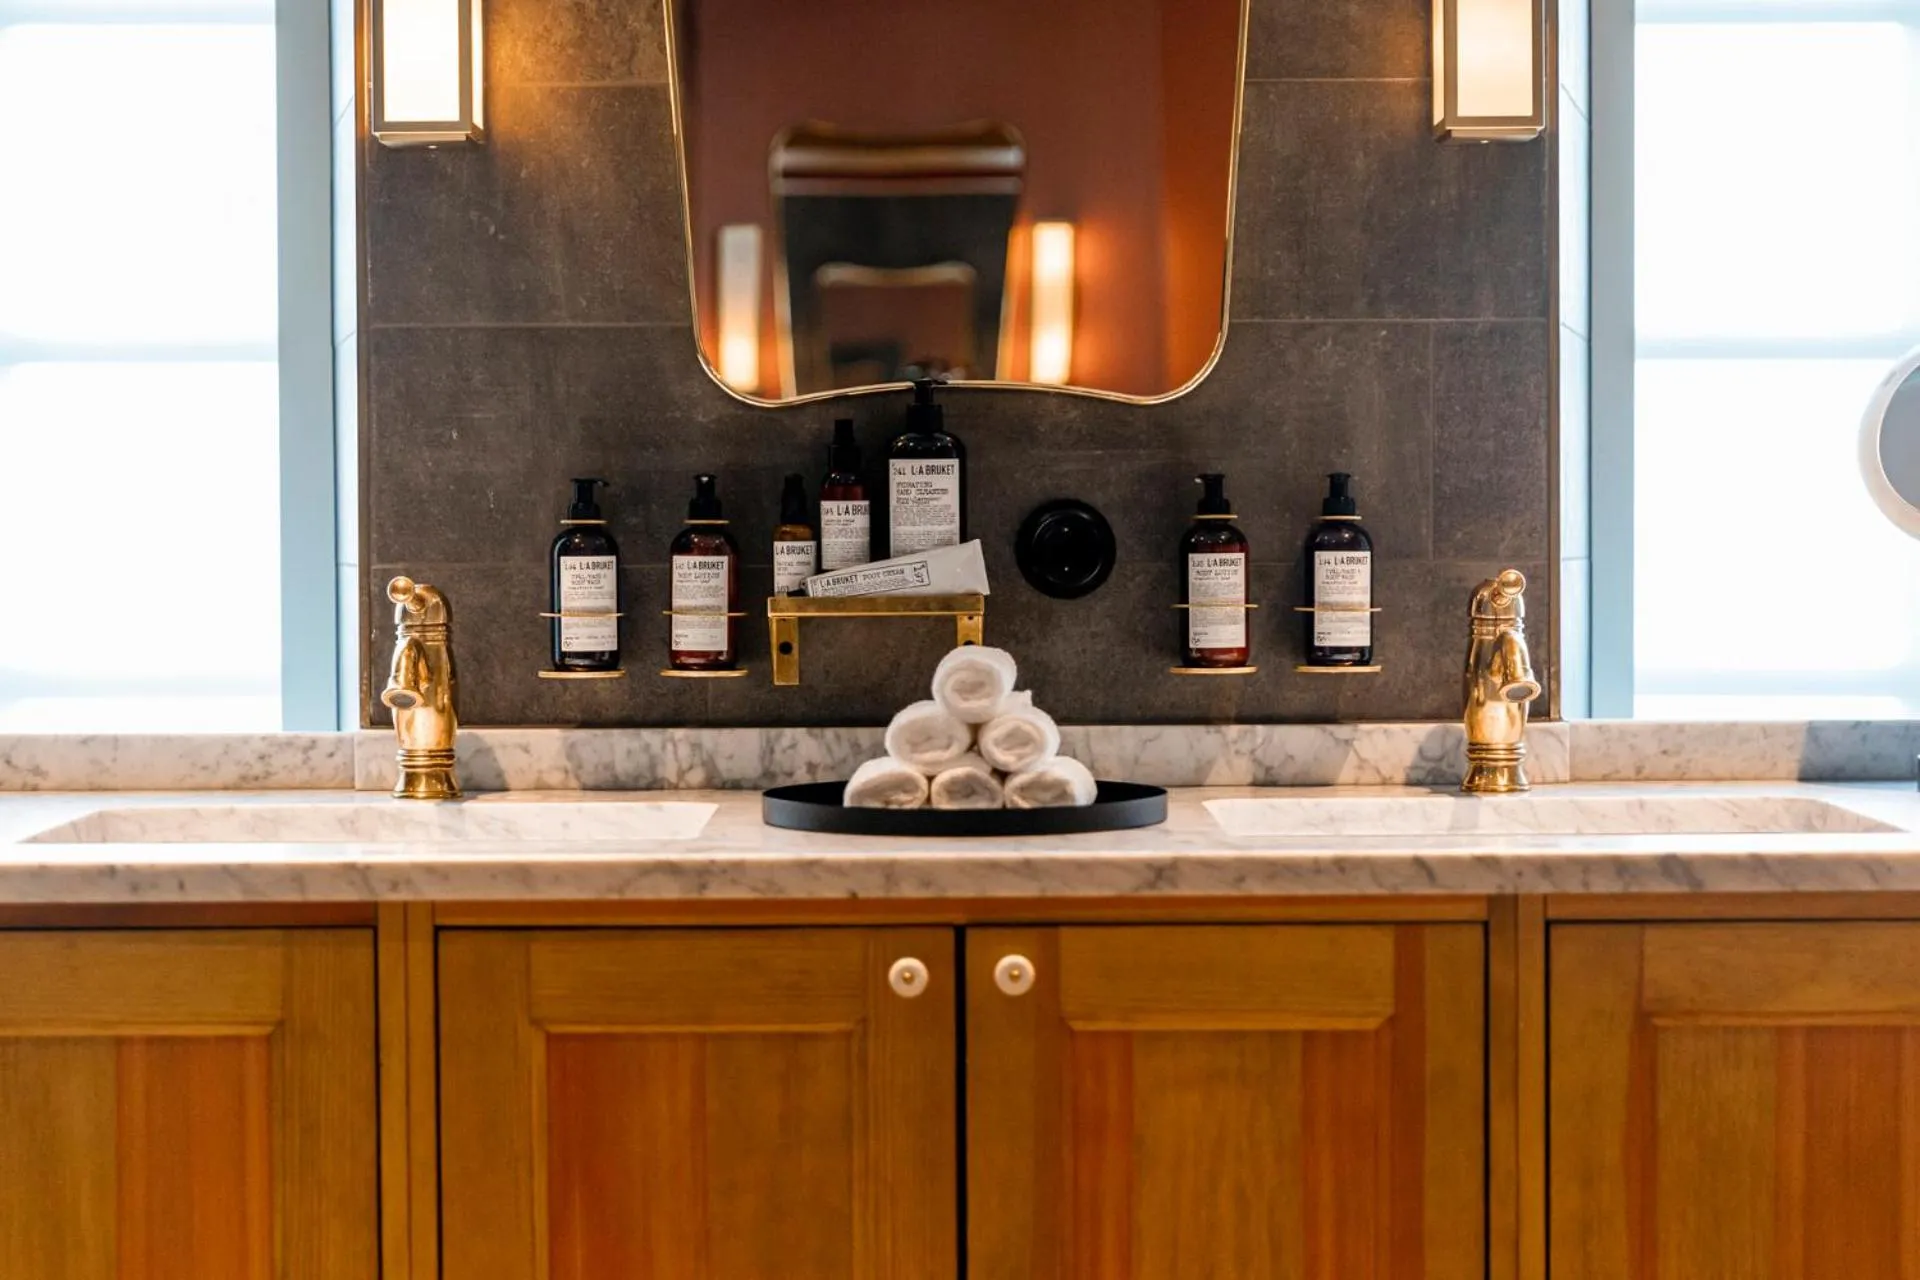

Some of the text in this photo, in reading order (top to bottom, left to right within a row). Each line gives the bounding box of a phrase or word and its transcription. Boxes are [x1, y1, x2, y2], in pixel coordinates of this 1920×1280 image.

[925, 464, 955, 475] BRUKET
[852, 504, 869, 515] BRU
[786, 545, 813, 555] BRUKET
[592, 560, 614, 570] BRUKET
[698, 561, 724, 570] BRUKET
[1219, 557, 1242, 567] BRUKET
[1346, 556, 1368, 565] BRUKET
[832, 574, 858, 585] BRUKET
